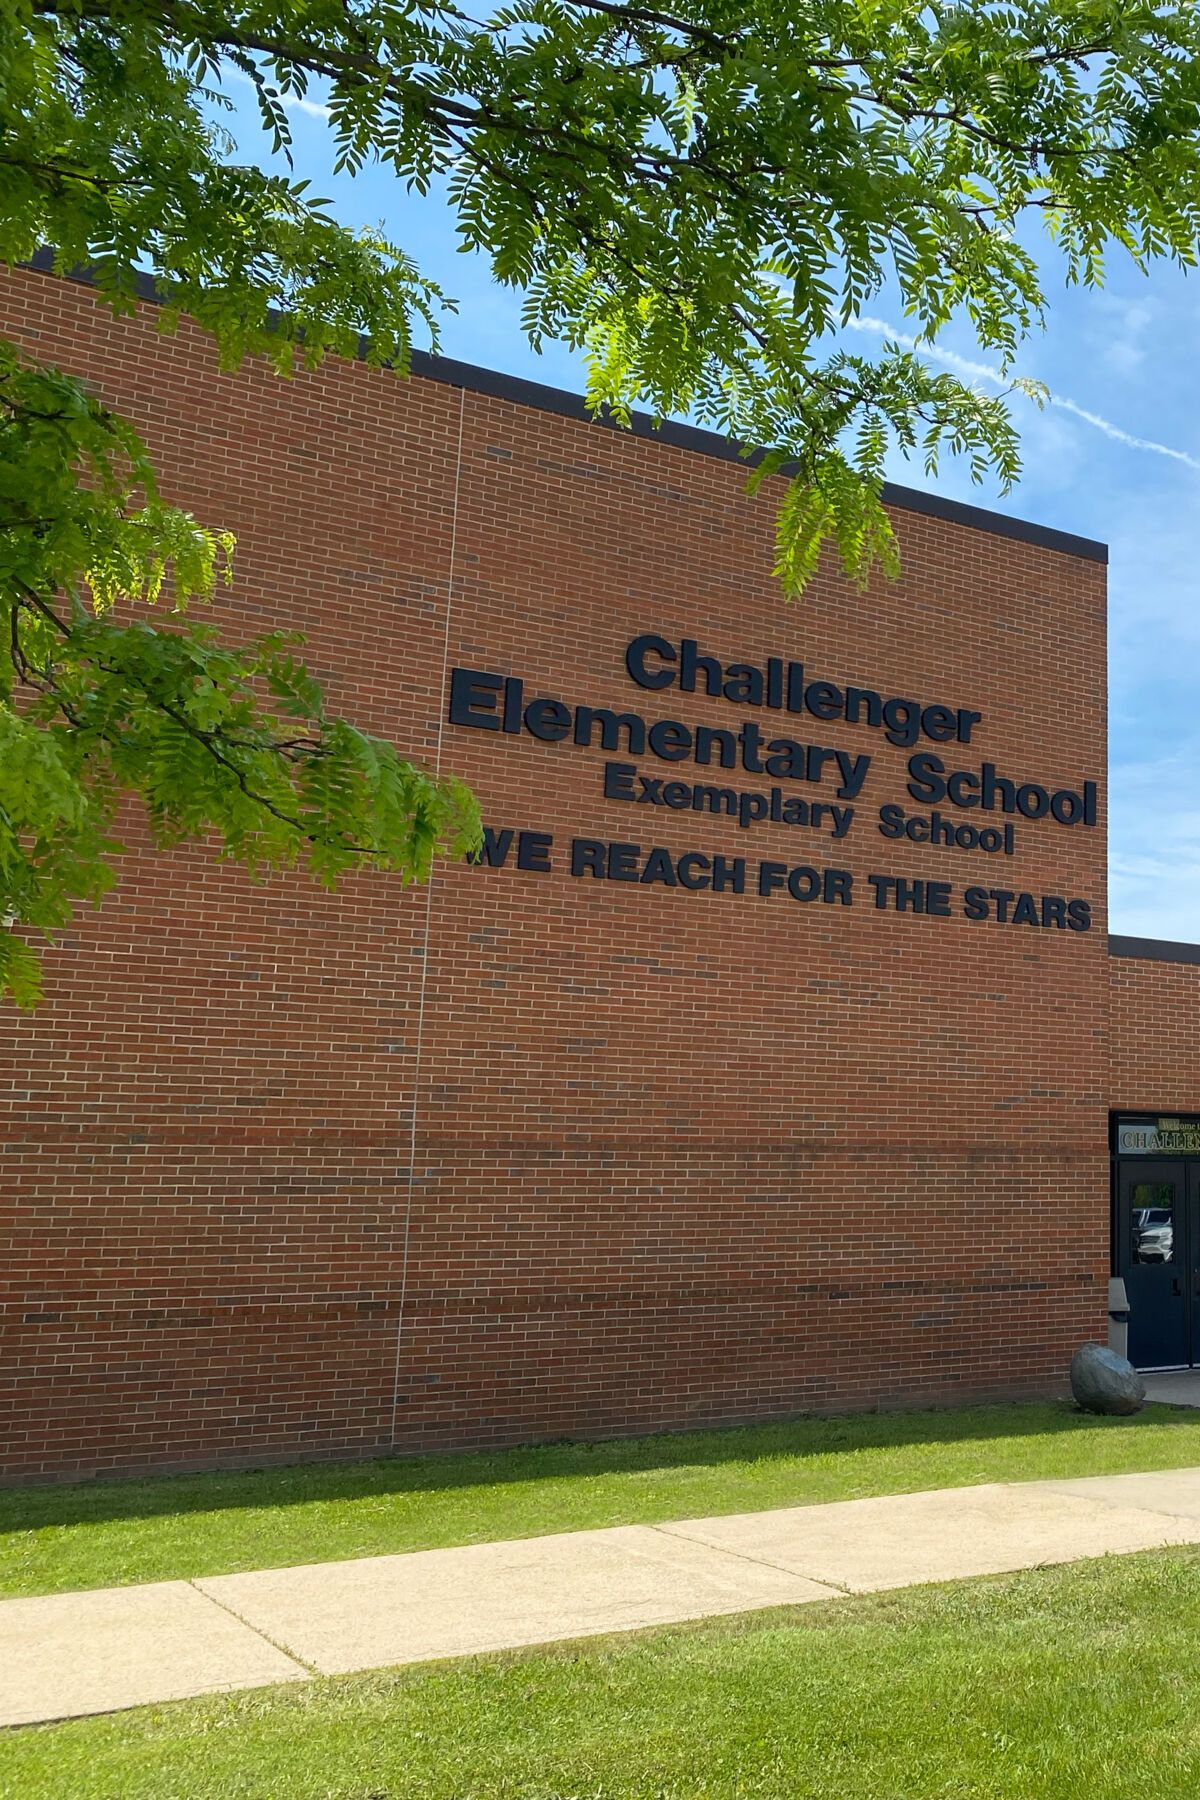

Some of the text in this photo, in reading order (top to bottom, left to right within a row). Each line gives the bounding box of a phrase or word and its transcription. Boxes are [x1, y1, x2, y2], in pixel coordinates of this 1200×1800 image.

[626, 635, 981, 747] Challenger
[449, 668, 1097, 825] Elementary School
[604, 762, 1014, 854] Exemplary School
[465, 827, 1091, 931] WE REACH FOR THE STARS
[1162, 1120, 1195, 1130] Welcome
